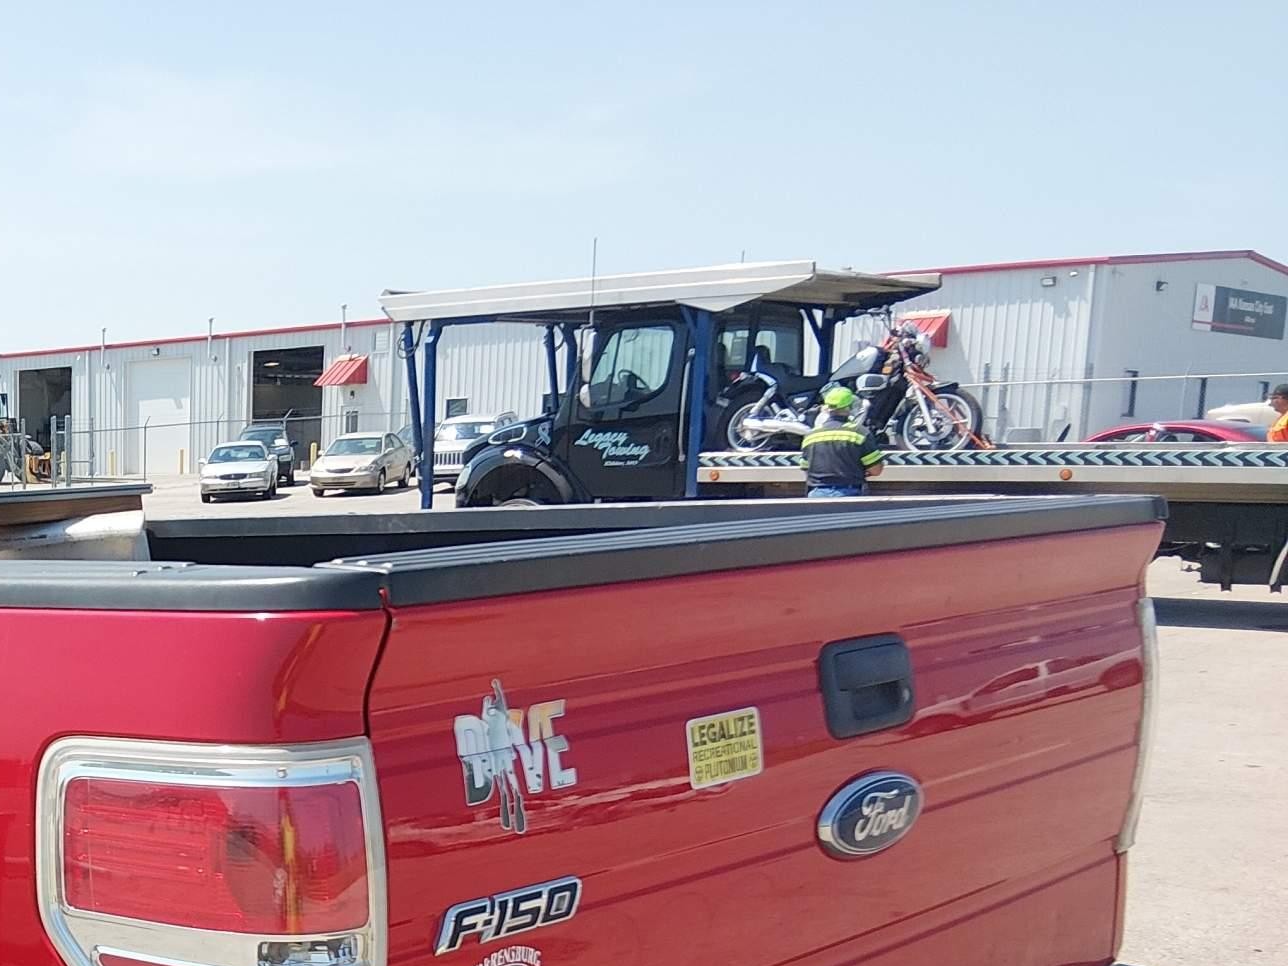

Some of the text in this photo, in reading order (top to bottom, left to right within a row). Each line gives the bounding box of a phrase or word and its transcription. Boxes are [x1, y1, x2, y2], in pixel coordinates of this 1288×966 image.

[574, 428, 629, 449] Legacy
[598, 443, 650, 461] Towing
[690, 713, 756, 748] LEGALIZE
[692, 739, 758, 763] RECREATIONAL
[704, 754, 748, 781] PLUTONIUM
[854, 788, 913, 842] Ford
[441, 879, 580, 953] F-150
